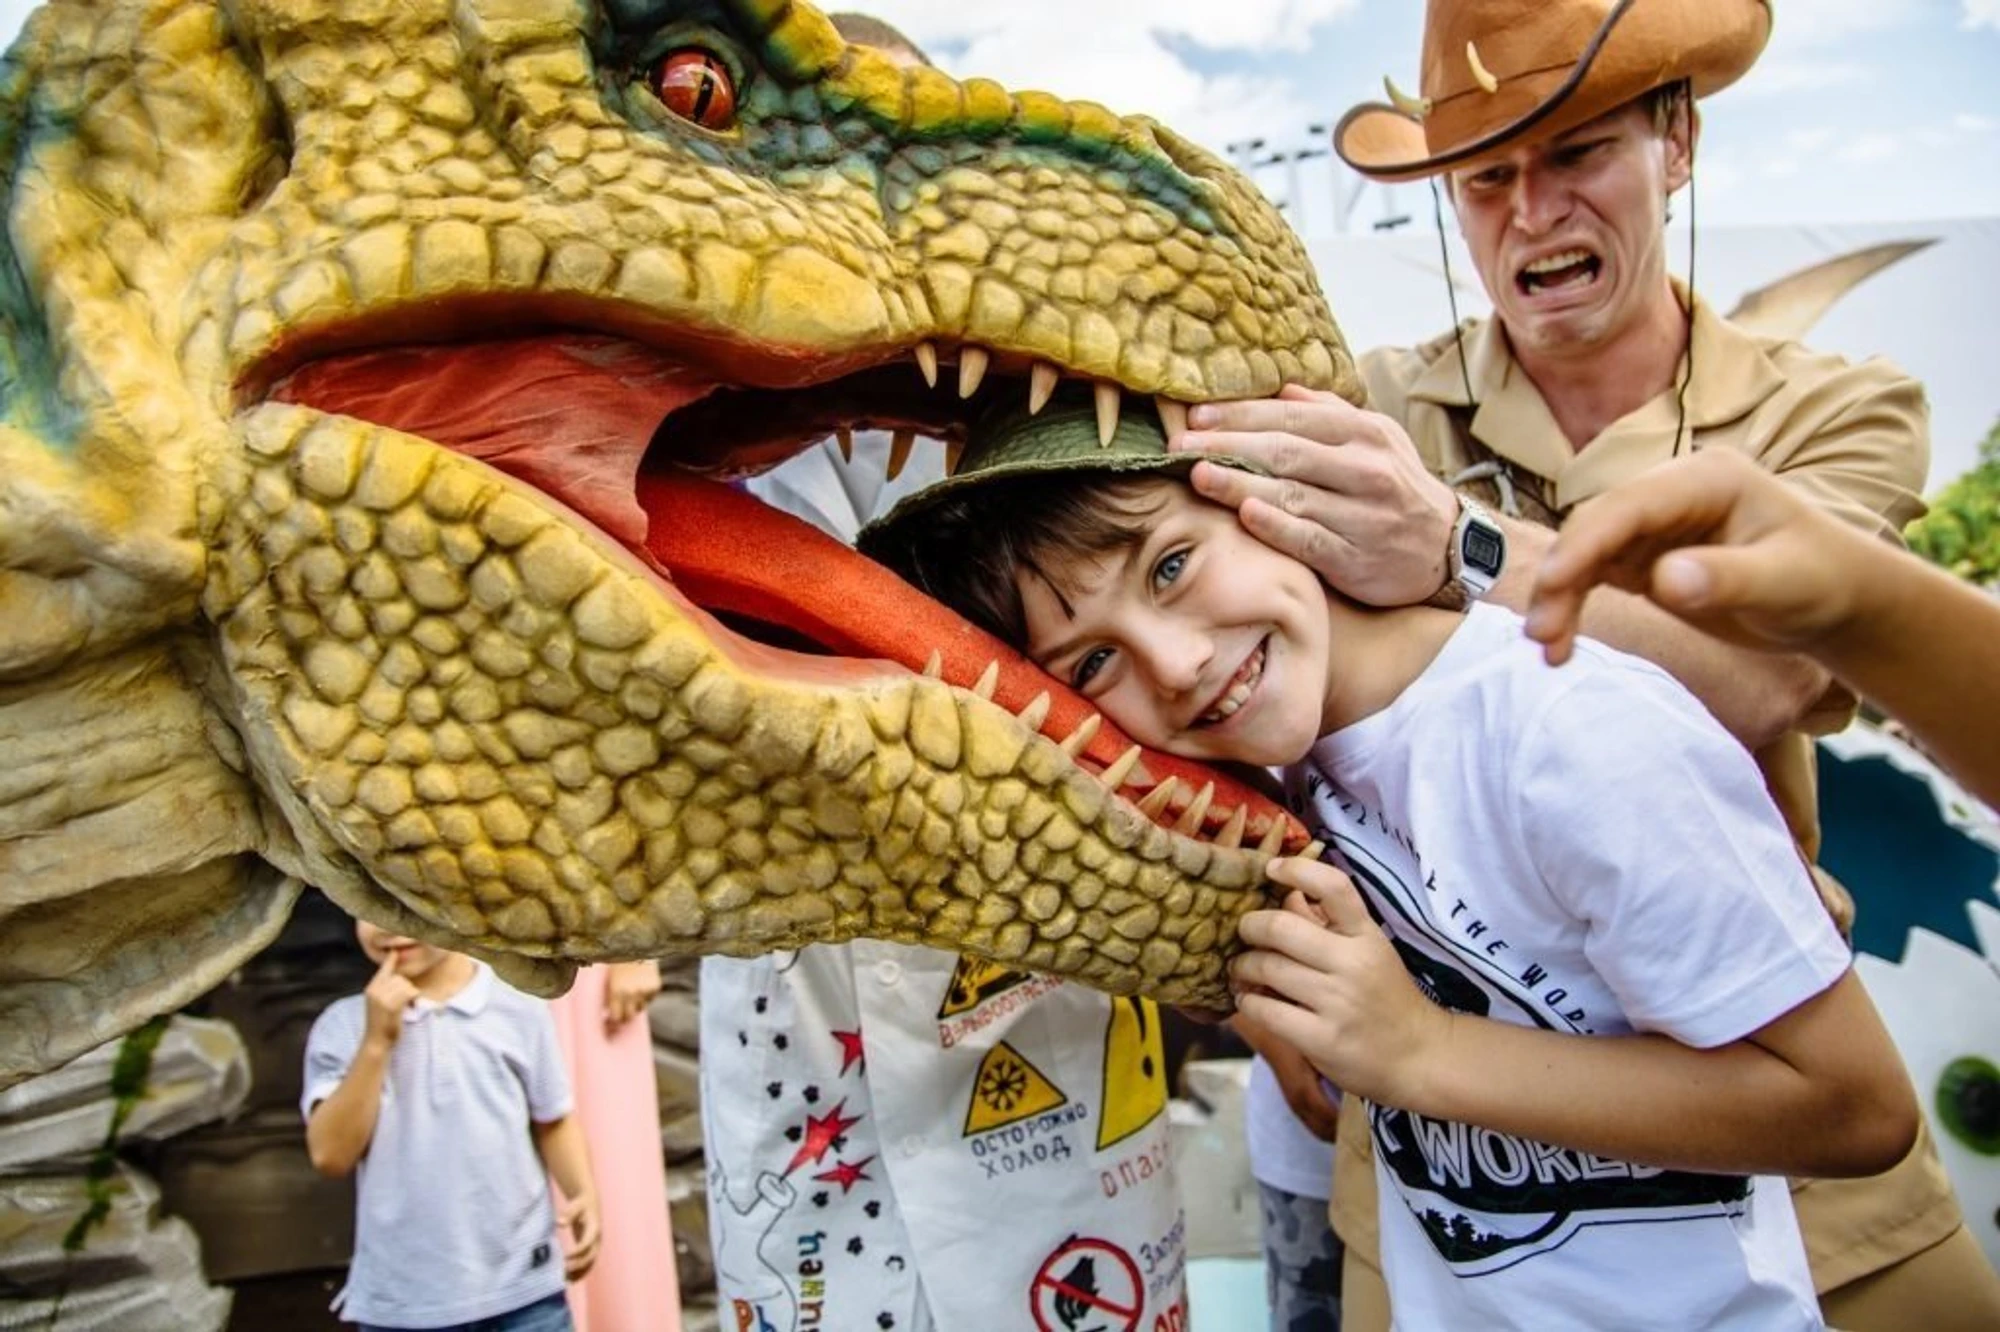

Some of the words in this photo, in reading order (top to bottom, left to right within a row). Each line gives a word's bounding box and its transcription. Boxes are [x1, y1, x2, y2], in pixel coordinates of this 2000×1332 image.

[1451, 898, 1510, 956] THE
[1520, 962, 1595, 1035] WOR
[978, 1134, 1072, 1180] ХОЛОД
